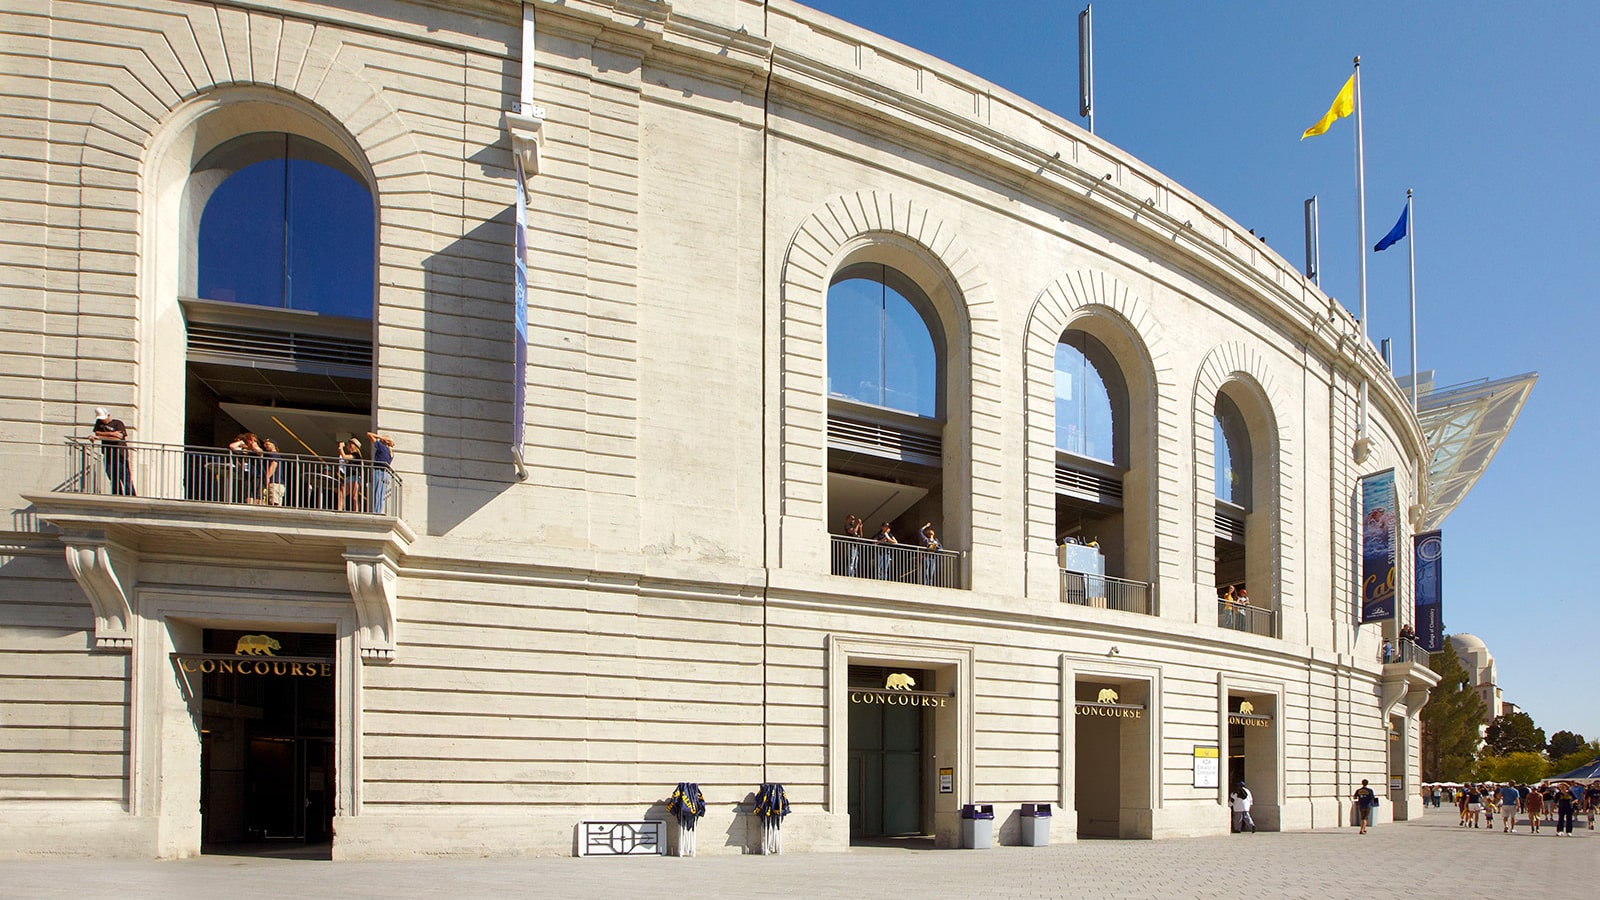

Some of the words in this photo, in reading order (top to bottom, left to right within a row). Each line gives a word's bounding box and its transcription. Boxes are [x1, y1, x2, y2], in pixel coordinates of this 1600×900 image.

[1363, 566, 1395, 603] Cal
[1428, 634, 1436, 649] College
[182, 658, 332, 677] CONCOURSE
[851, 692, 947, 707] CONCOURSE
[1074, 705, 1141, 719] CONCOURSE
[1228, 716, 1269, 728] ONCOURSE
